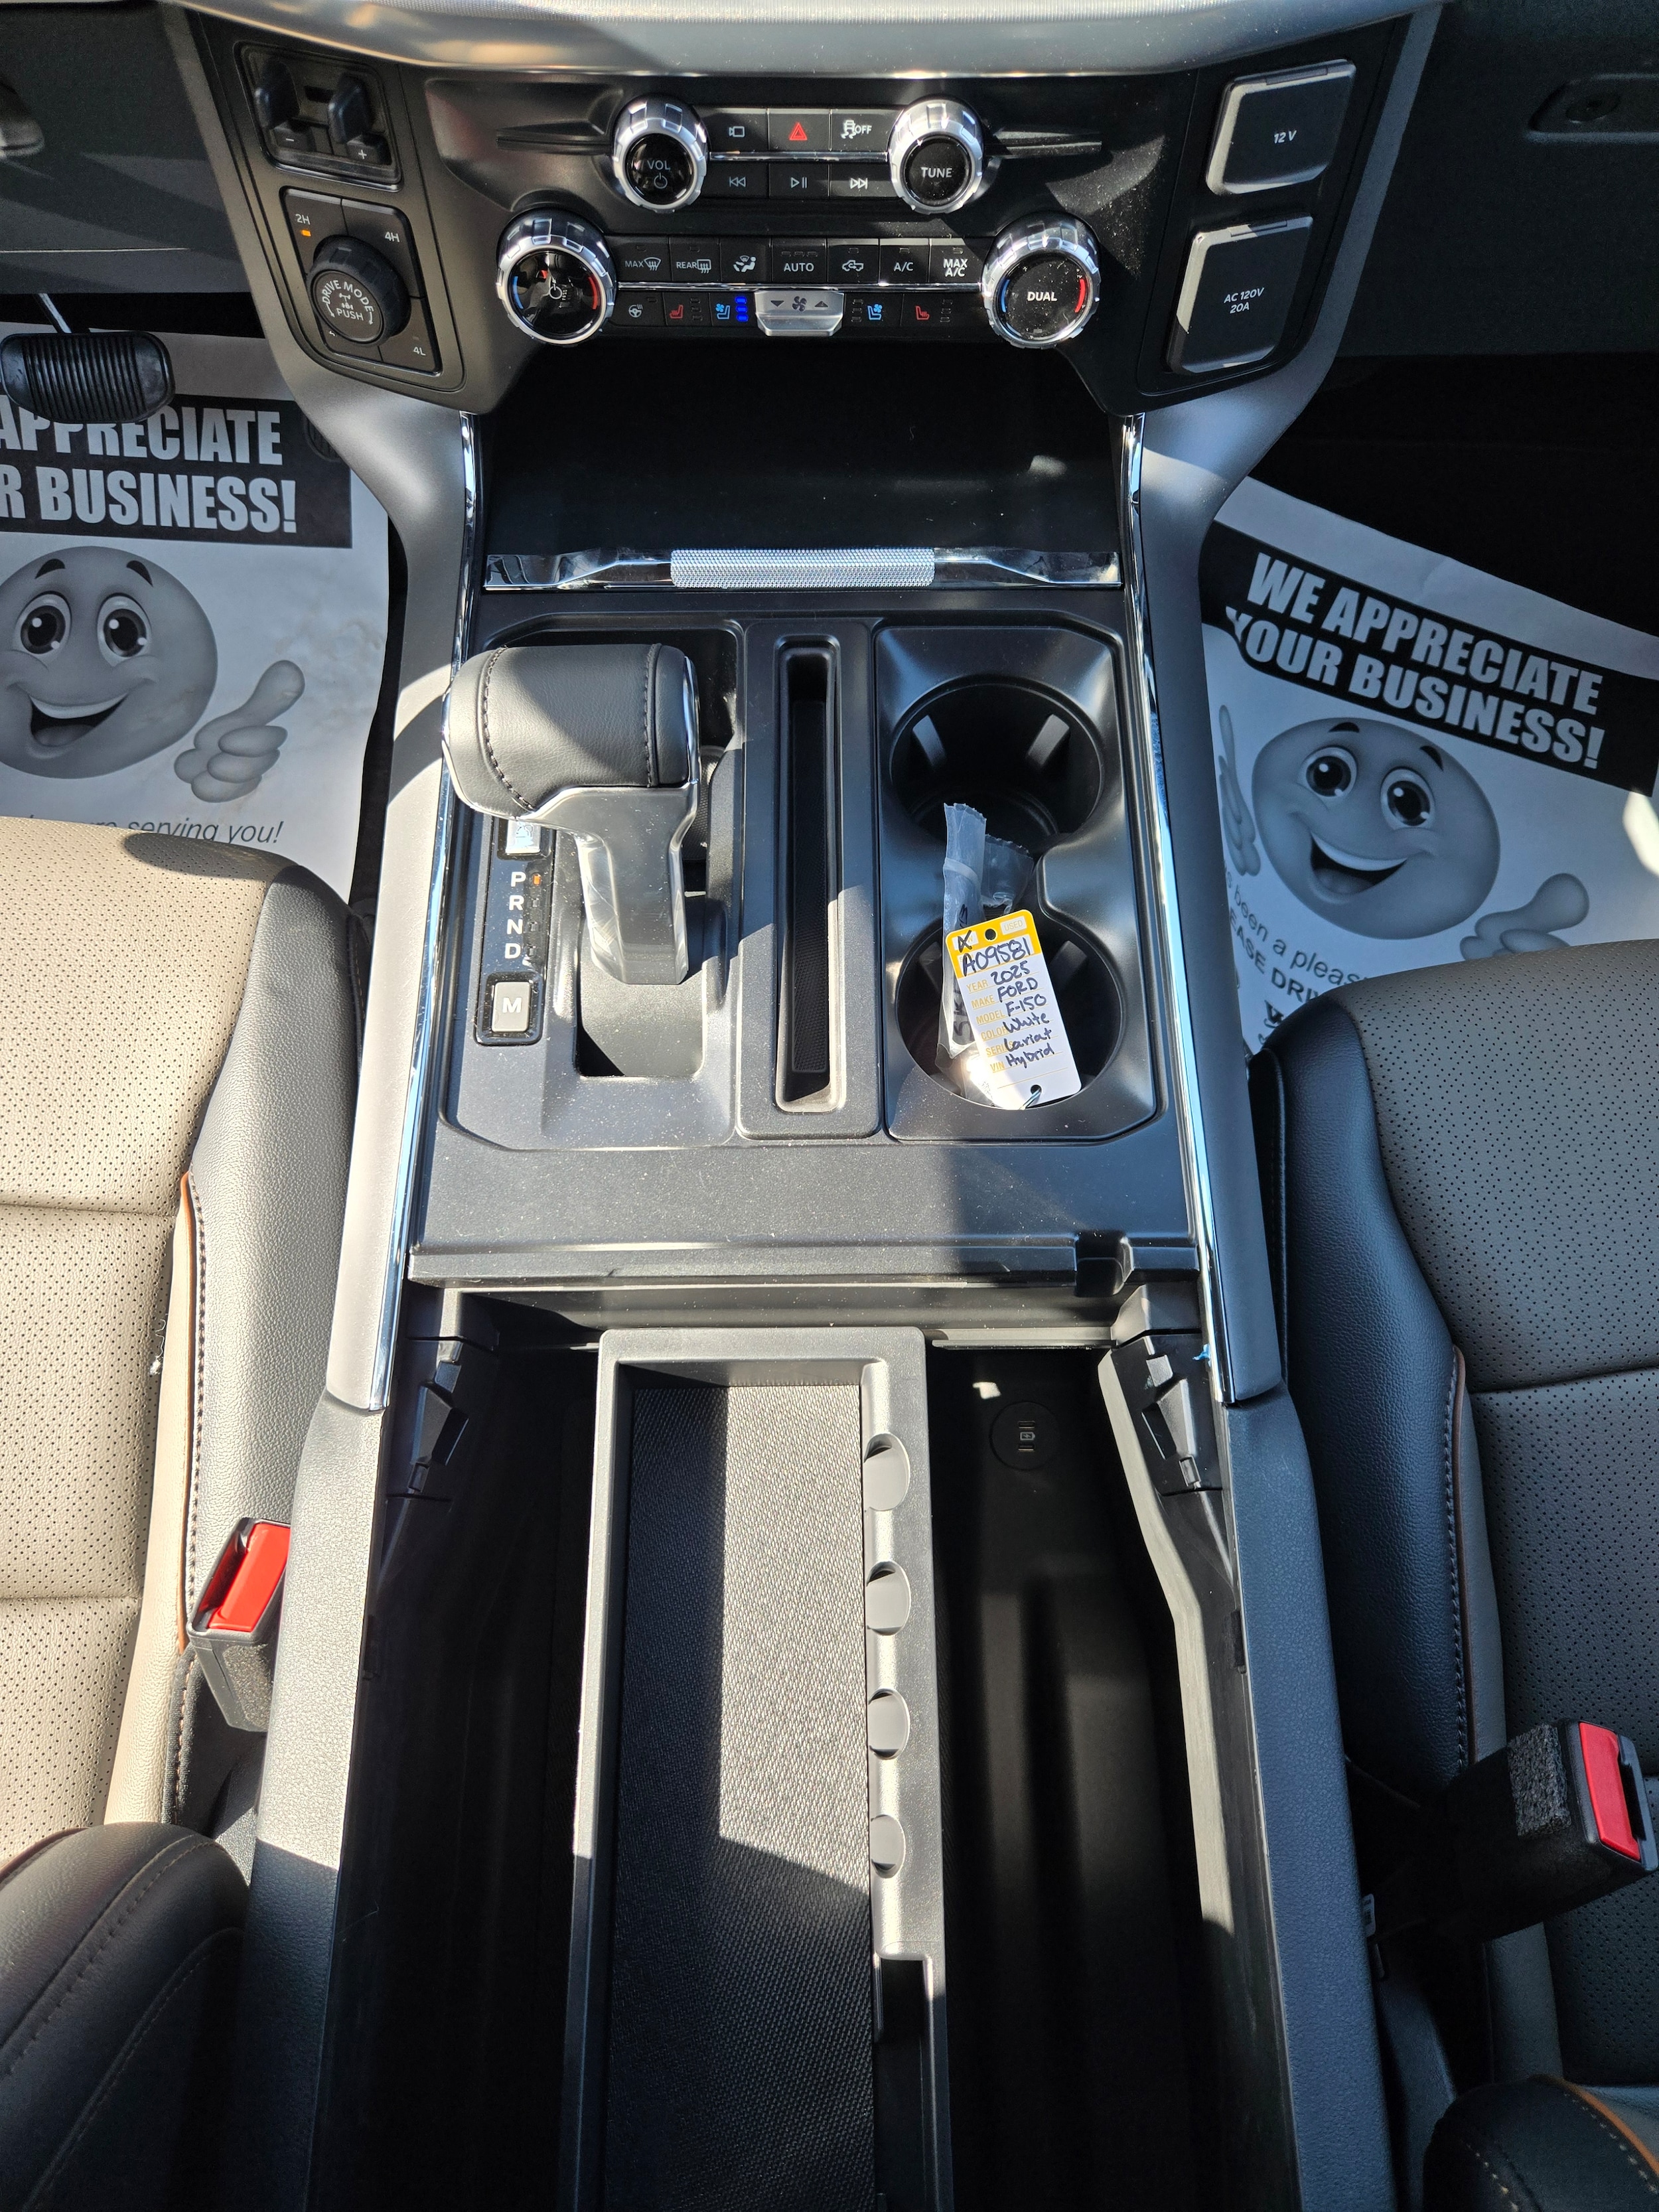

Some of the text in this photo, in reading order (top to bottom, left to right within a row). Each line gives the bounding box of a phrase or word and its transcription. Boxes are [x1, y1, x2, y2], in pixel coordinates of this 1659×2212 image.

[855, 125, 872, 135] OFF
[647, 160, 670, 171] VOL
[920, 167, 953, 179] TUNE
[295, 213, 310, 226] 2H
[384, 231, 399, 243] 4H
[676, 261, 697, 270] REAR
[783, 262, 815, 272] AUTO
[893, 261, 914, 272] A/C
[943, 258, 968, 269] MAX
[945, 267, 966, 277] A/C
[322, 279, 374, 313] DRIVE MODE
[1027, 290, 1058, 303] DUAL
[1224, 287, 1265, 303] AC 120V
[336, 307, 364, 321] PUSH
[1230, 302, 1250, 314] 20A
[413, 346, 426, 356] 4L
[36, 466, 297, 534] BUSINESS!
[1247, 552, 1603, 715] WE APPRECIATE
[1225, 605, 1606, 769] YOUR BUSINESS!
[510, 871, 526, 887] P
[509, 895, 524, 911] R
[507, 919, 524, 934] N
[1004, 919, 1024, 932] USED
[1234, 885, 1269, 942] been
[1273, 938, 1287, 957] a
[1230, 907, 1267, 975] EASE
[504, 942, 522, 959] D
[962, 936, 1031, 977] A09581
[990, 960, 1031, 986] 2025
[966, 979, 989, 993] YEAR
[997, 977, 1039, 1003] FORD
[502, 997, 522, 1013] M
[971, 994, 995, 1009] MAKE
[1005, 993, 1047, 1017] F-150
[975, 1009, 1005, 1025] MODEL
[1003, 1011, 1050, 1033] White
[985, 1040, 1014, 1056] SERIS
[1005, 1042, 1056, 1069] Hybrid
[989, 1061, 1005, 1072] VIN
